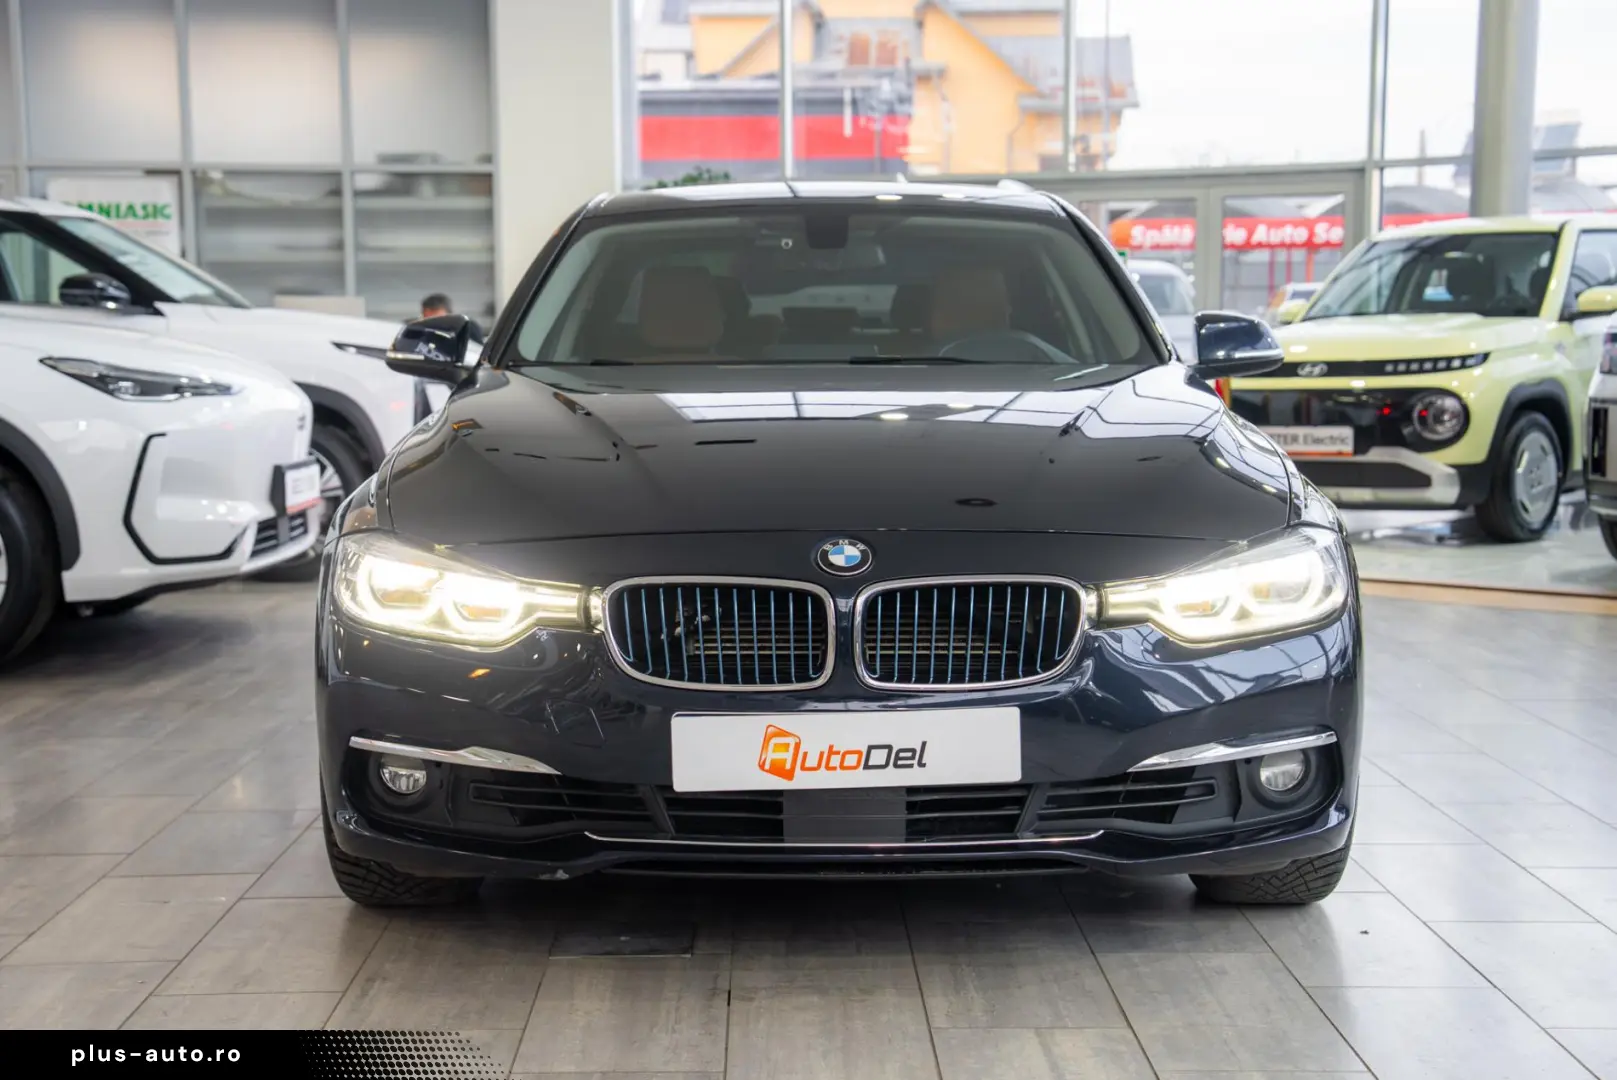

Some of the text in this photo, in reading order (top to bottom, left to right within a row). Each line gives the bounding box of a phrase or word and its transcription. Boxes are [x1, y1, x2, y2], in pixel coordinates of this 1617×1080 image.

[1251, 224, 1309, 245] Auto
[1303, 431, 1349, 446] Electric
[761, 732, 927, 775] AutoDel
